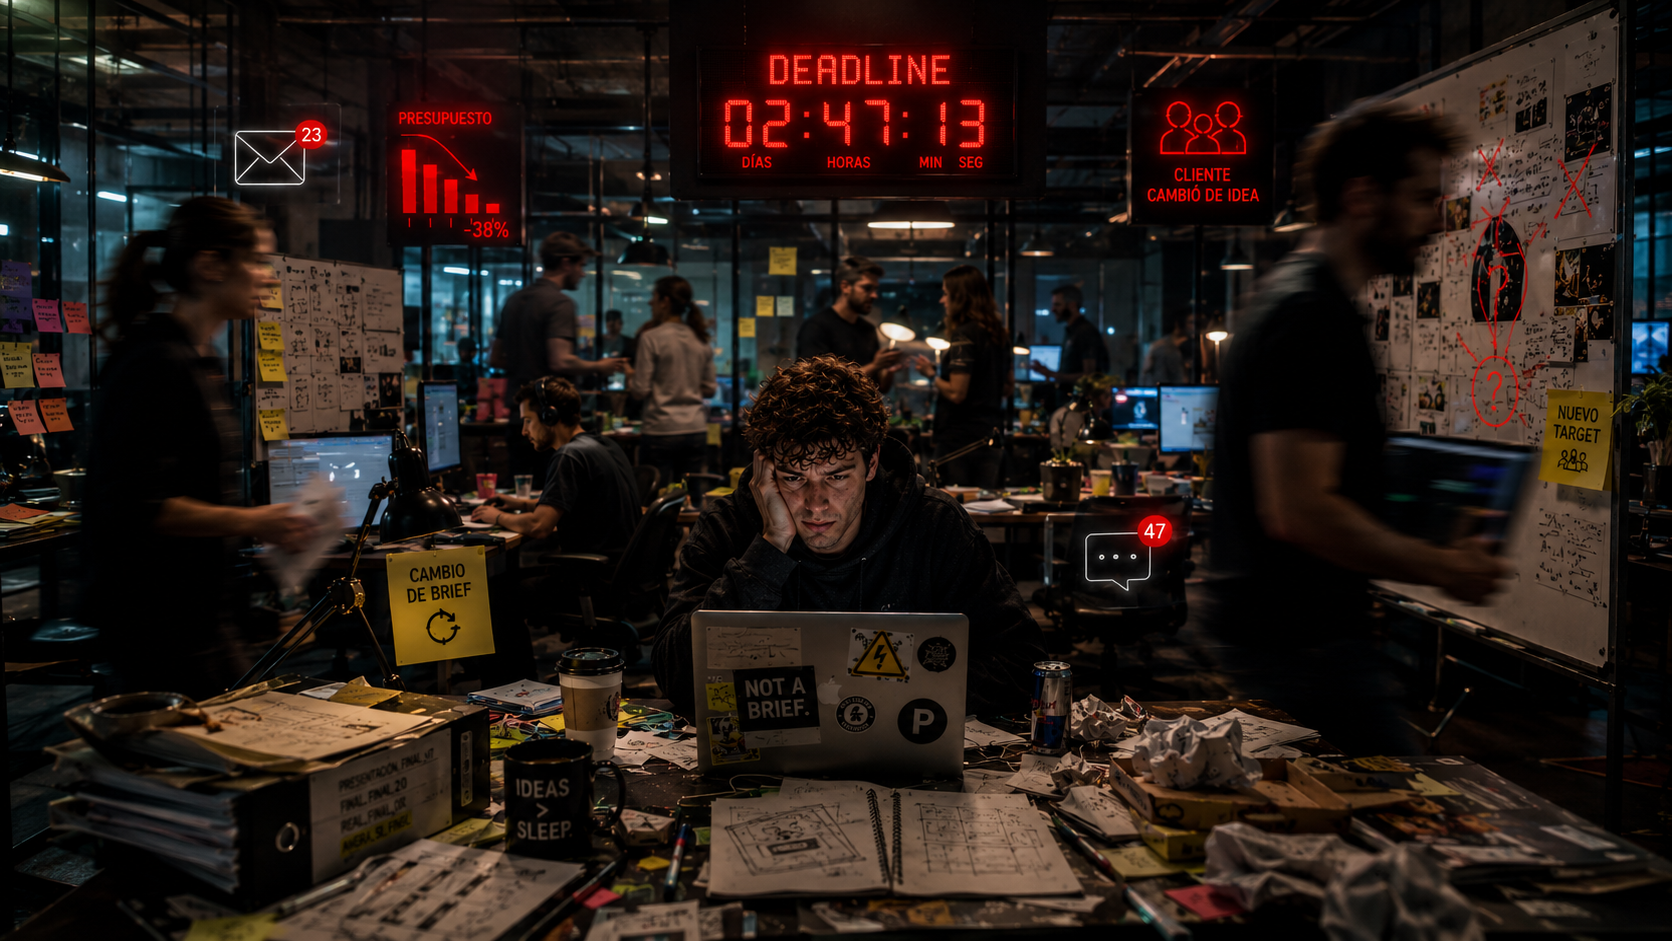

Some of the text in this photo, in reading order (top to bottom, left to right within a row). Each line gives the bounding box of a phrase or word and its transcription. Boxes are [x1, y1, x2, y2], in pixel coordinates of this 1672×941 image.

[769, 55, 950, 84] DEADLINE
[398, 111, 492, 125] PRESUPUESTO
[724, 99, 985, 148] 02:47:13
[741, 154, 983, 168] DÍAS HORAS MIN SEG
[1174, 167, 1231, 182] CLIENTE
[1147, 184, 1260, 202] CAMBIÓ DE IDEA
[463, 221, 509, 238] -38%
[1557, 404, 1599, 423] NUEVO
[1553, 423, 1602, 444] TARGET
[409, 563, 466, 583] CAMBIO
[406, 581, 472, 604] DE BRIEF
[744, 677, 785, 698] NOT
[791, 676, 807, 695] A
[747, 698, 810, 720] BRIEF.
[912, 708, 935, 735] P
[515, 778, 570, 799] IDEAS
